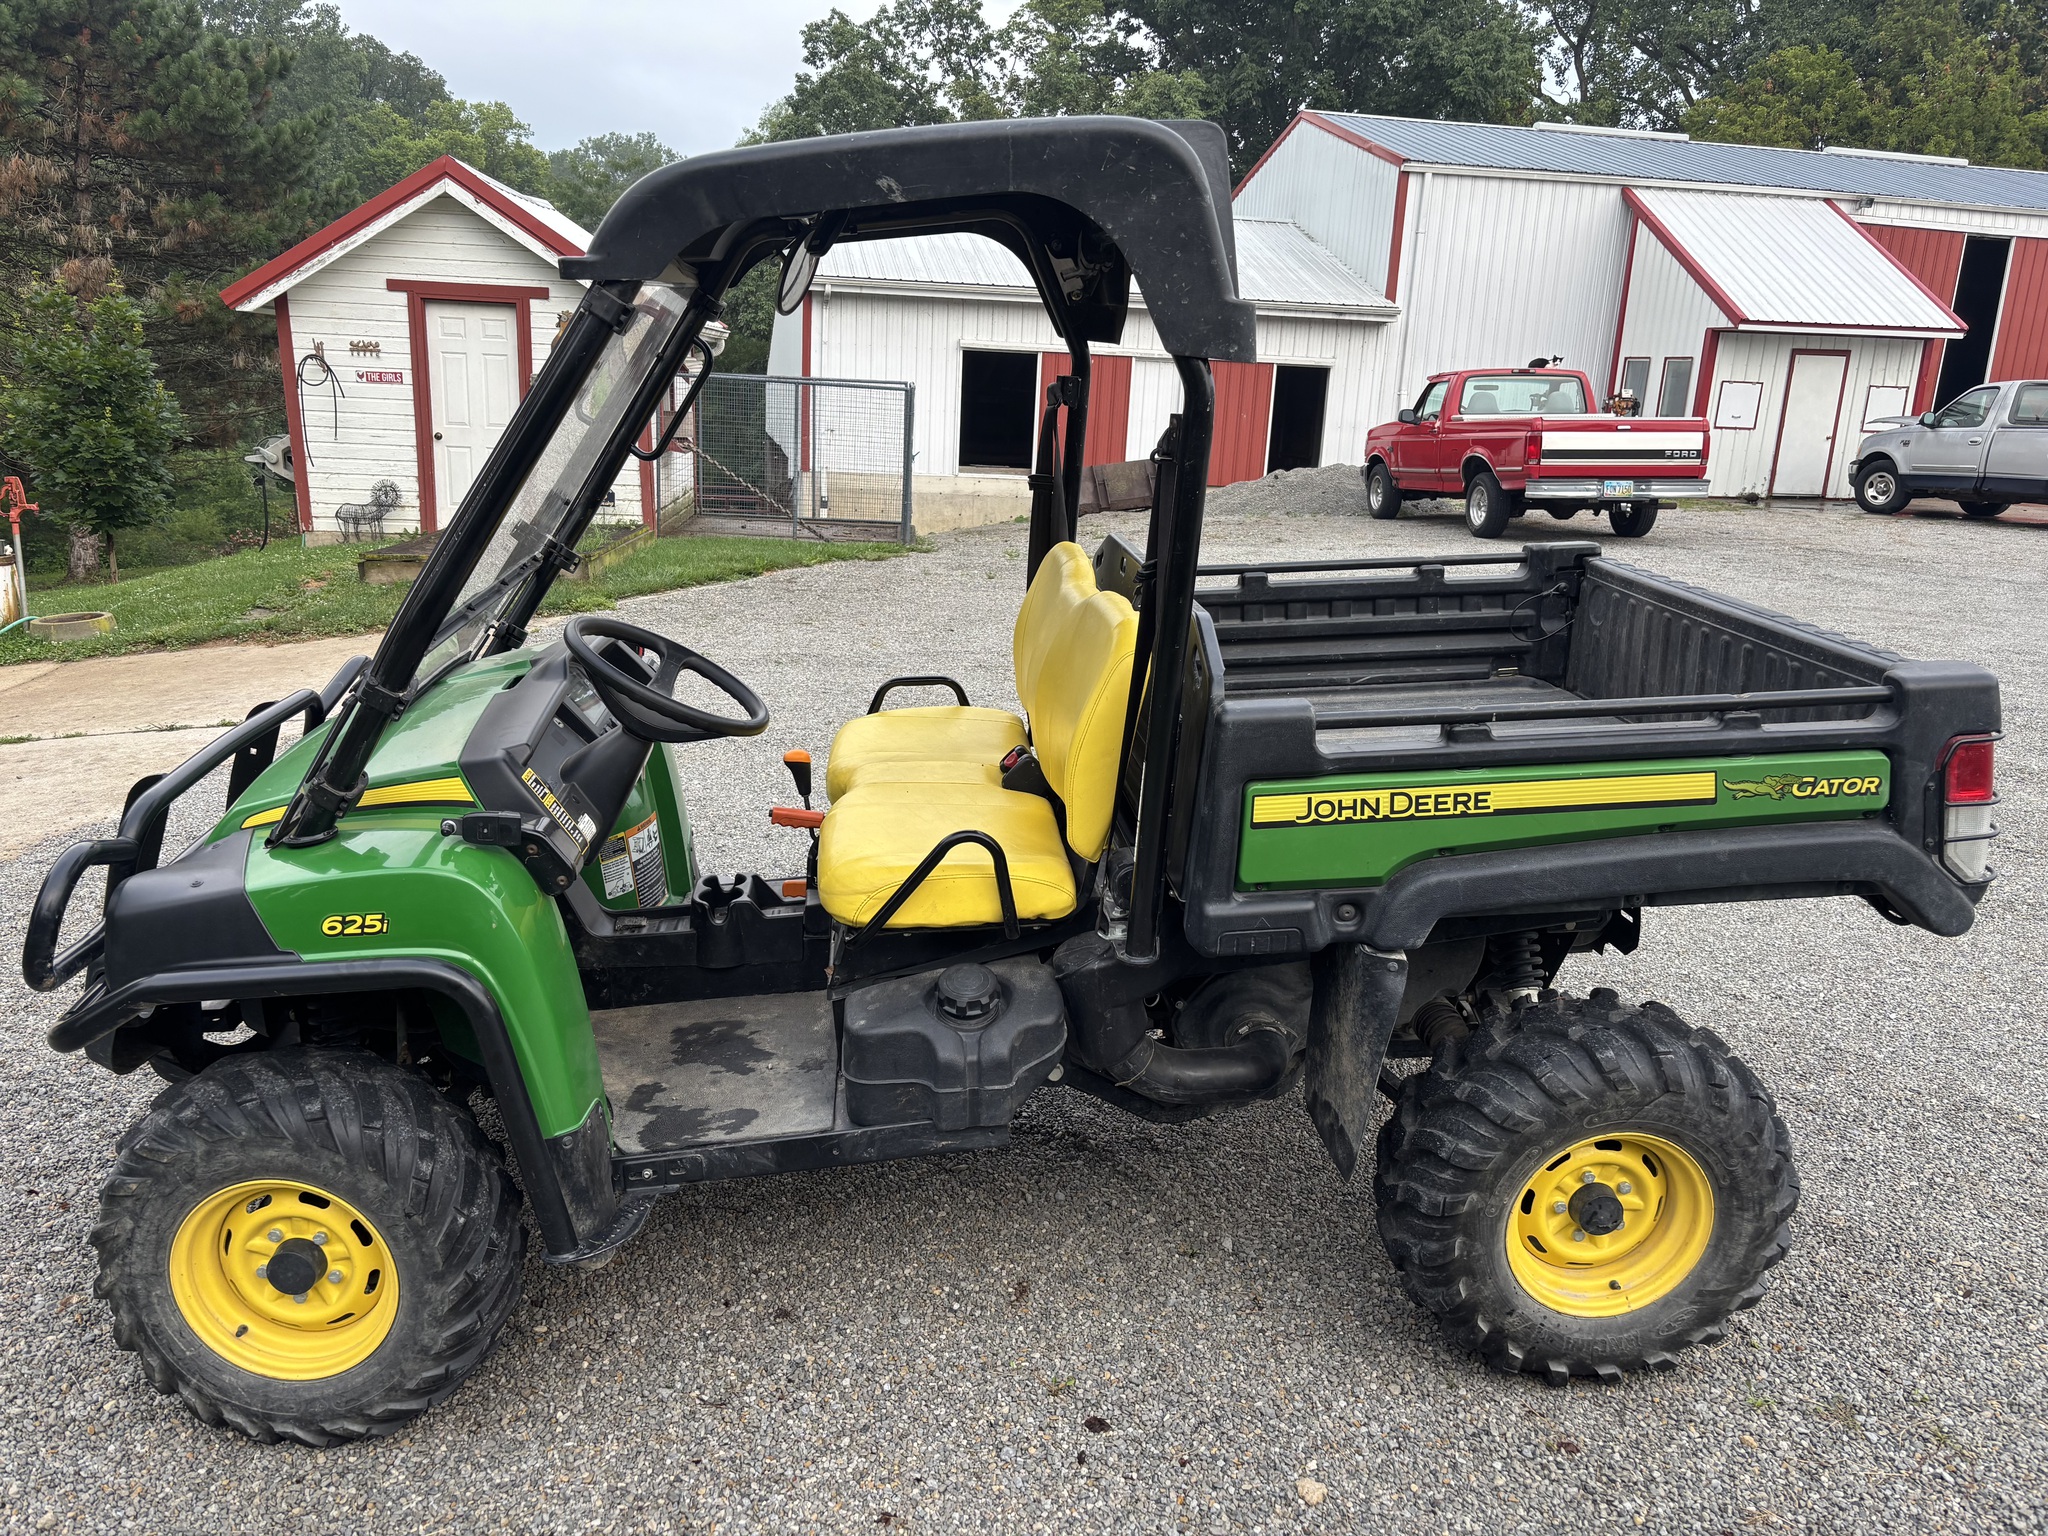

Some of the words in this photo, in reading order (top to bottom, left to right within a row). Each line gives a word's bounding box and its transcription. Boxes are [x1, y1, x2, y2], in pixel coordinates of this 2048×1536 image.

[366, 372, 380, 382] THE
[381, 372, 402, 383] GIRLS
[1664, 450, 1697, 458] FORD
[1791, 776, 1881, 798] GATOR
[1295, 796, 1382, 822] JOHN
[1389, 791, 1492, 817] DEERE
[321, 913, 389, 936] 625i
